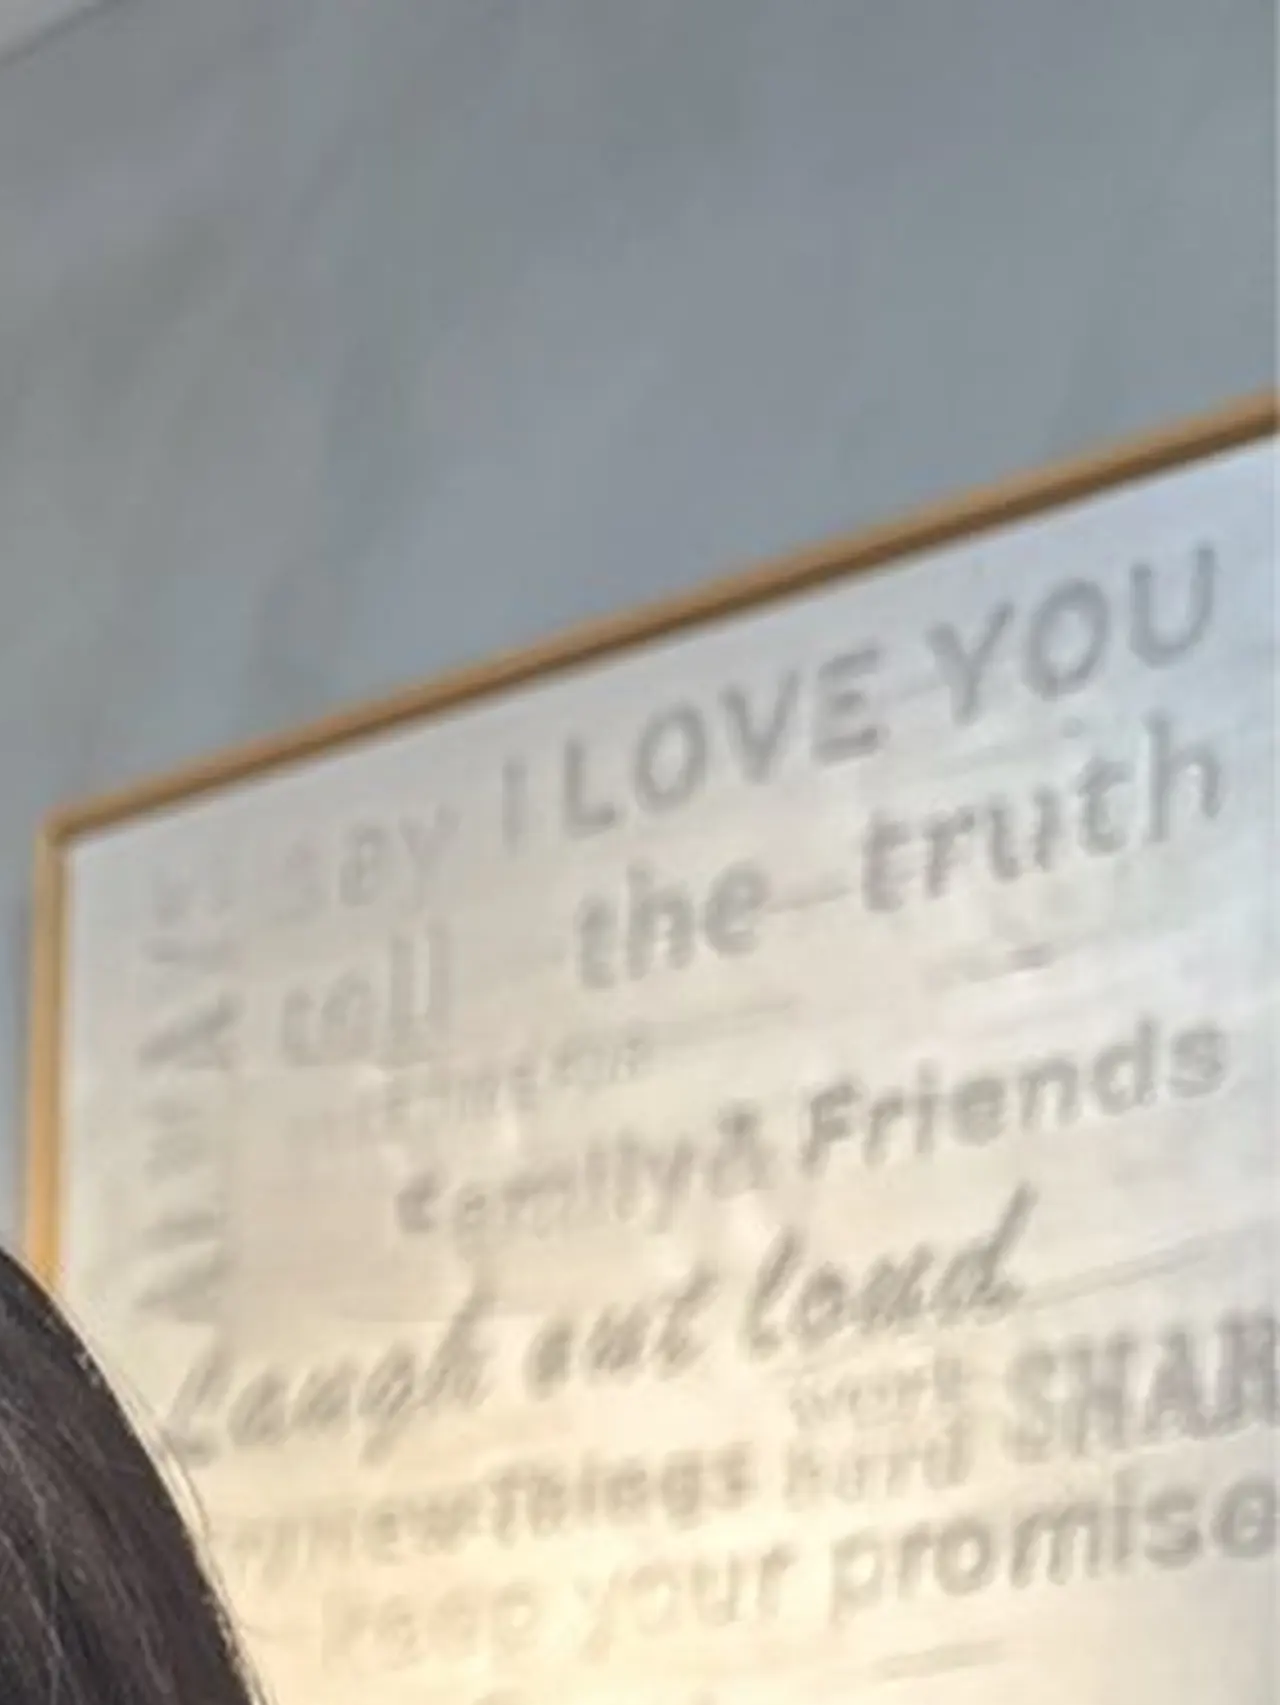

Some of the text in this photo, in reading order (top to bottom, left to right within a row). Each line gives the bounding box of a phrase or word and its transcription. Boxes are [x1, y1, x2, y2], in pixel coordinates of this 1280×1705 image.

[561, 640, 886, 842] LOVE
[922, 541, 1221, 727] YOU
[573, 857, 772, 993] the
[860, 706, 1225, 913] truth
[796, 1013, 1232, 1180] Friends
